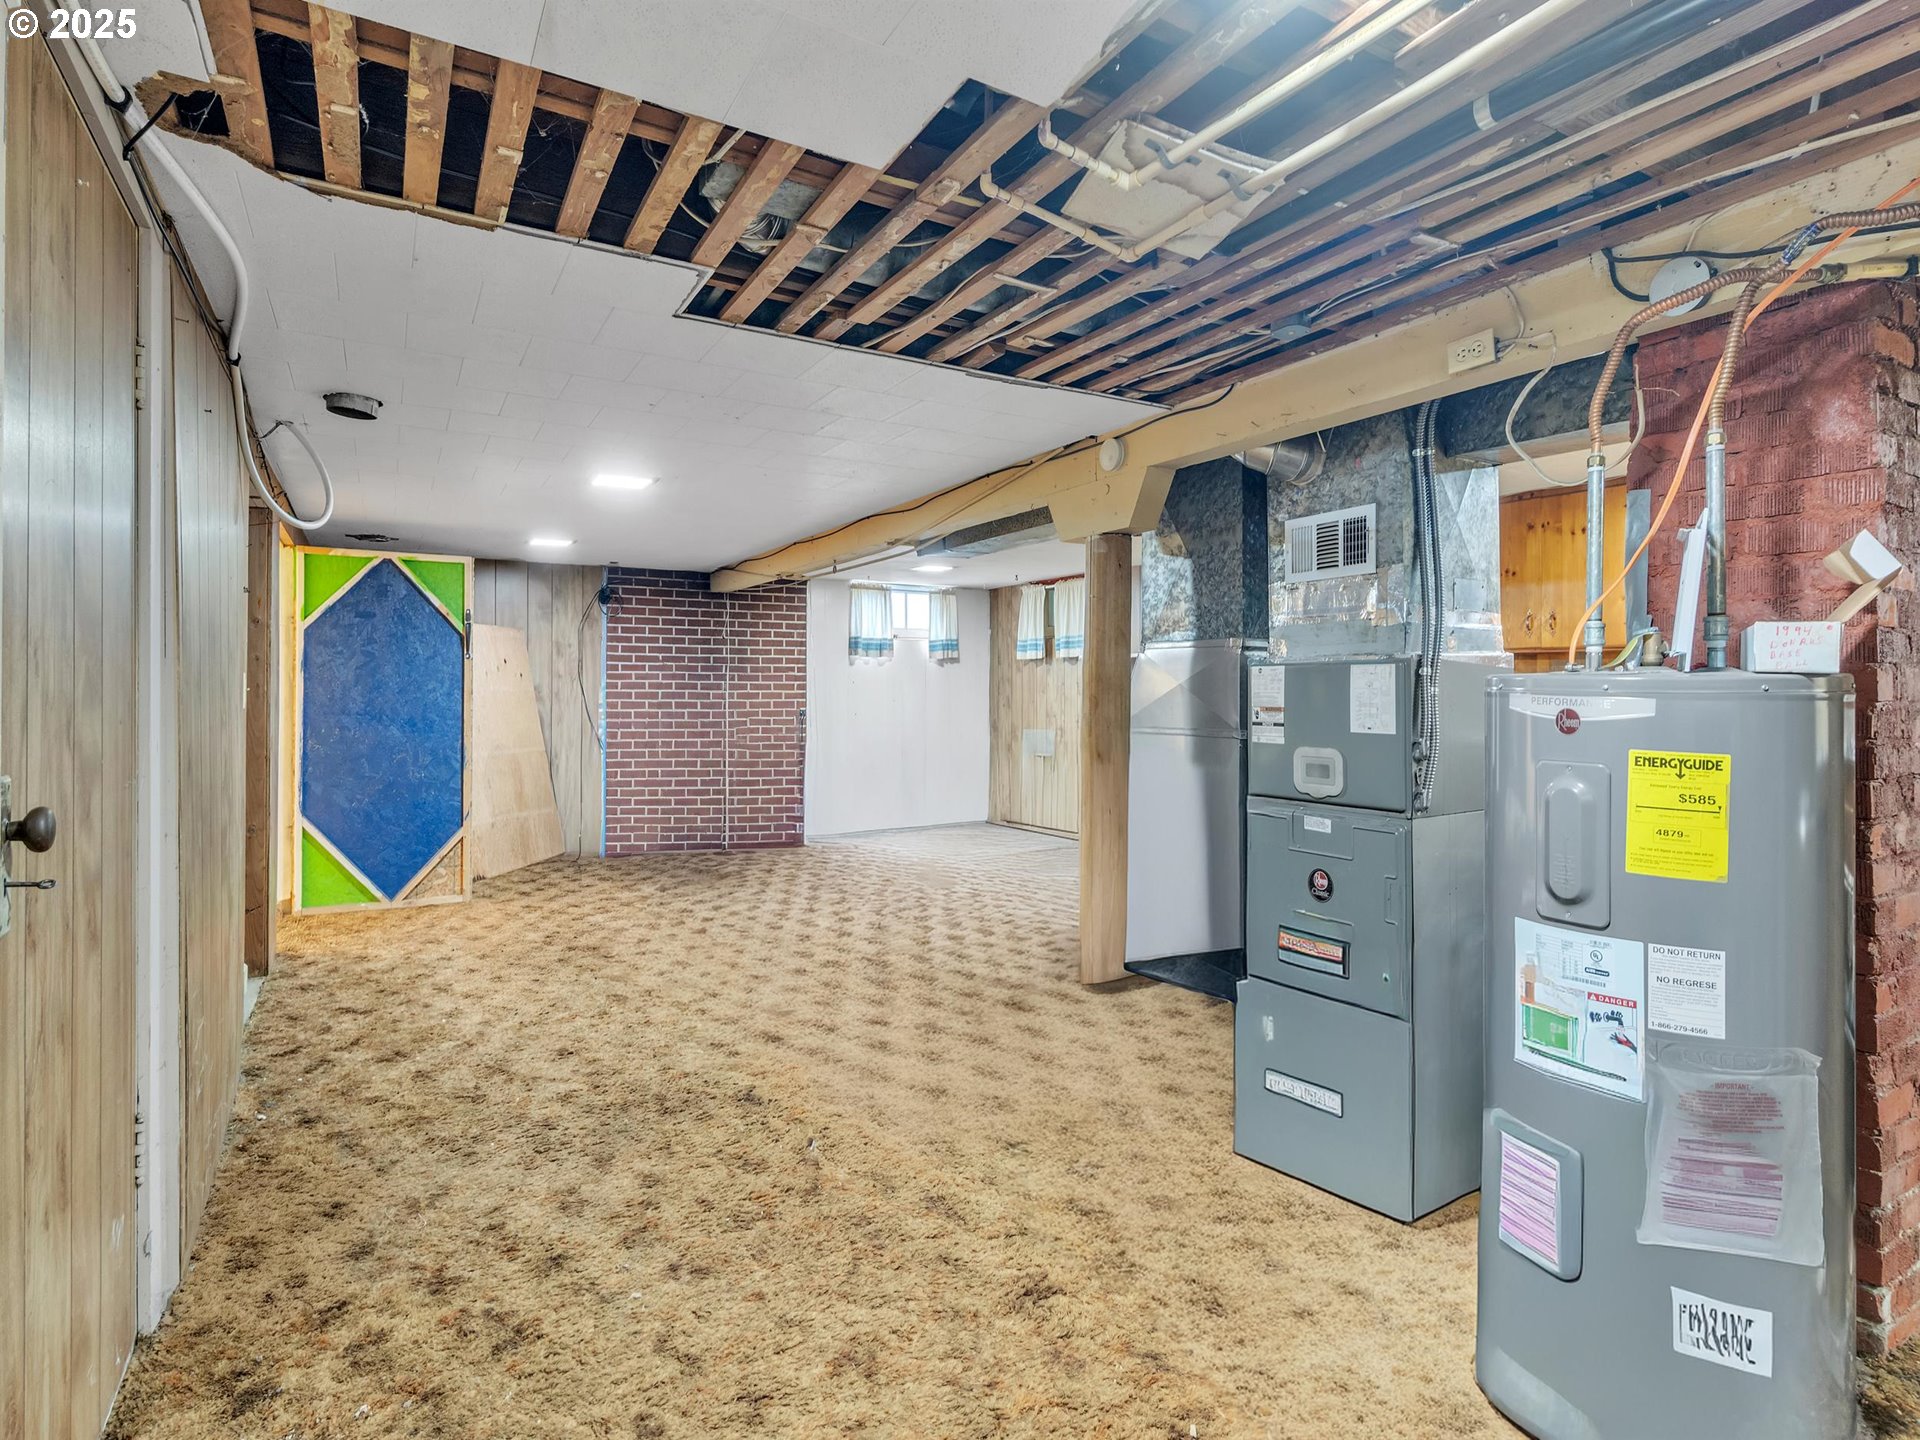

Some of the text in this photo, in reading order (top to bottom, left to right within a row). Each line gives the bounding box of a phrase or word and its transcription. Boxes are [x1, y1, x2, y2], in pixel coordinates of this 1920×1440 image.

[1775, 625, 1812, 636] 1994
[1634, 755, 1724, 772] ENERGYGUIDE
[1678, 793, 1717, 806] $585
[1655, 828, 1684, 838] 4879
[1652, 945, 1721, 961] DO NOT RETURN
[1656, 975, 1718, 990] NO REGRESE
[1598, 993, 1635, 1008] DANGER
